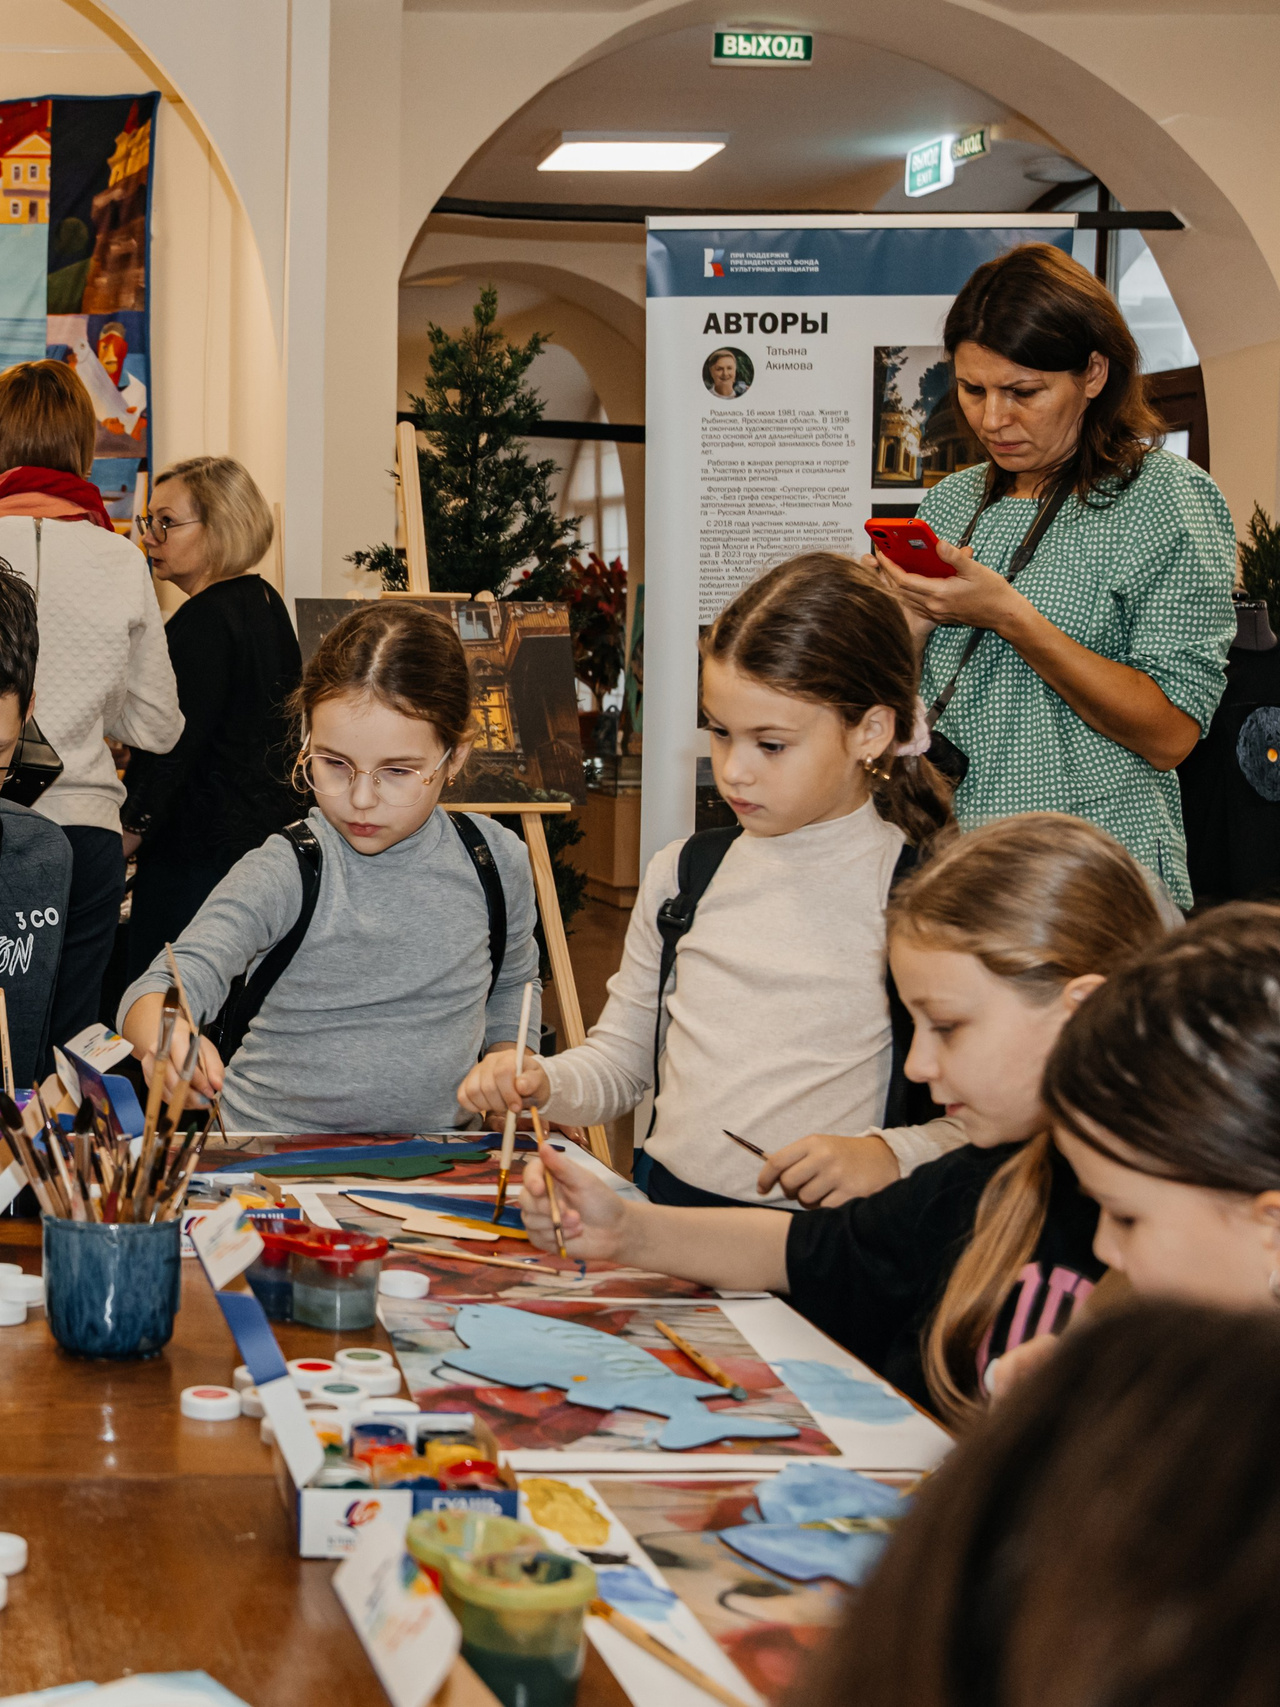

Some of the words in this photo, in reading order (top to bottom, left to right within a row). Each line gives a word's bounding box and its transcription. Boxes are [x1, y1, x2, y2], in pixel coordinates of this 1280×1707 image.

[722, 35, 805, 59] ВЫХОД
[911, 144, 940, 173] ВЫХОД
[916, 168, 933, 187] EXIT
[703, 312, 829, 335] АВТОРЫ
[766, 345, 808, 356] Татьяна
[765, 361, 813, 370] Акимова
[707, 485, 742, 493] Фотограф
[717, 509, 746, 517] Русская
